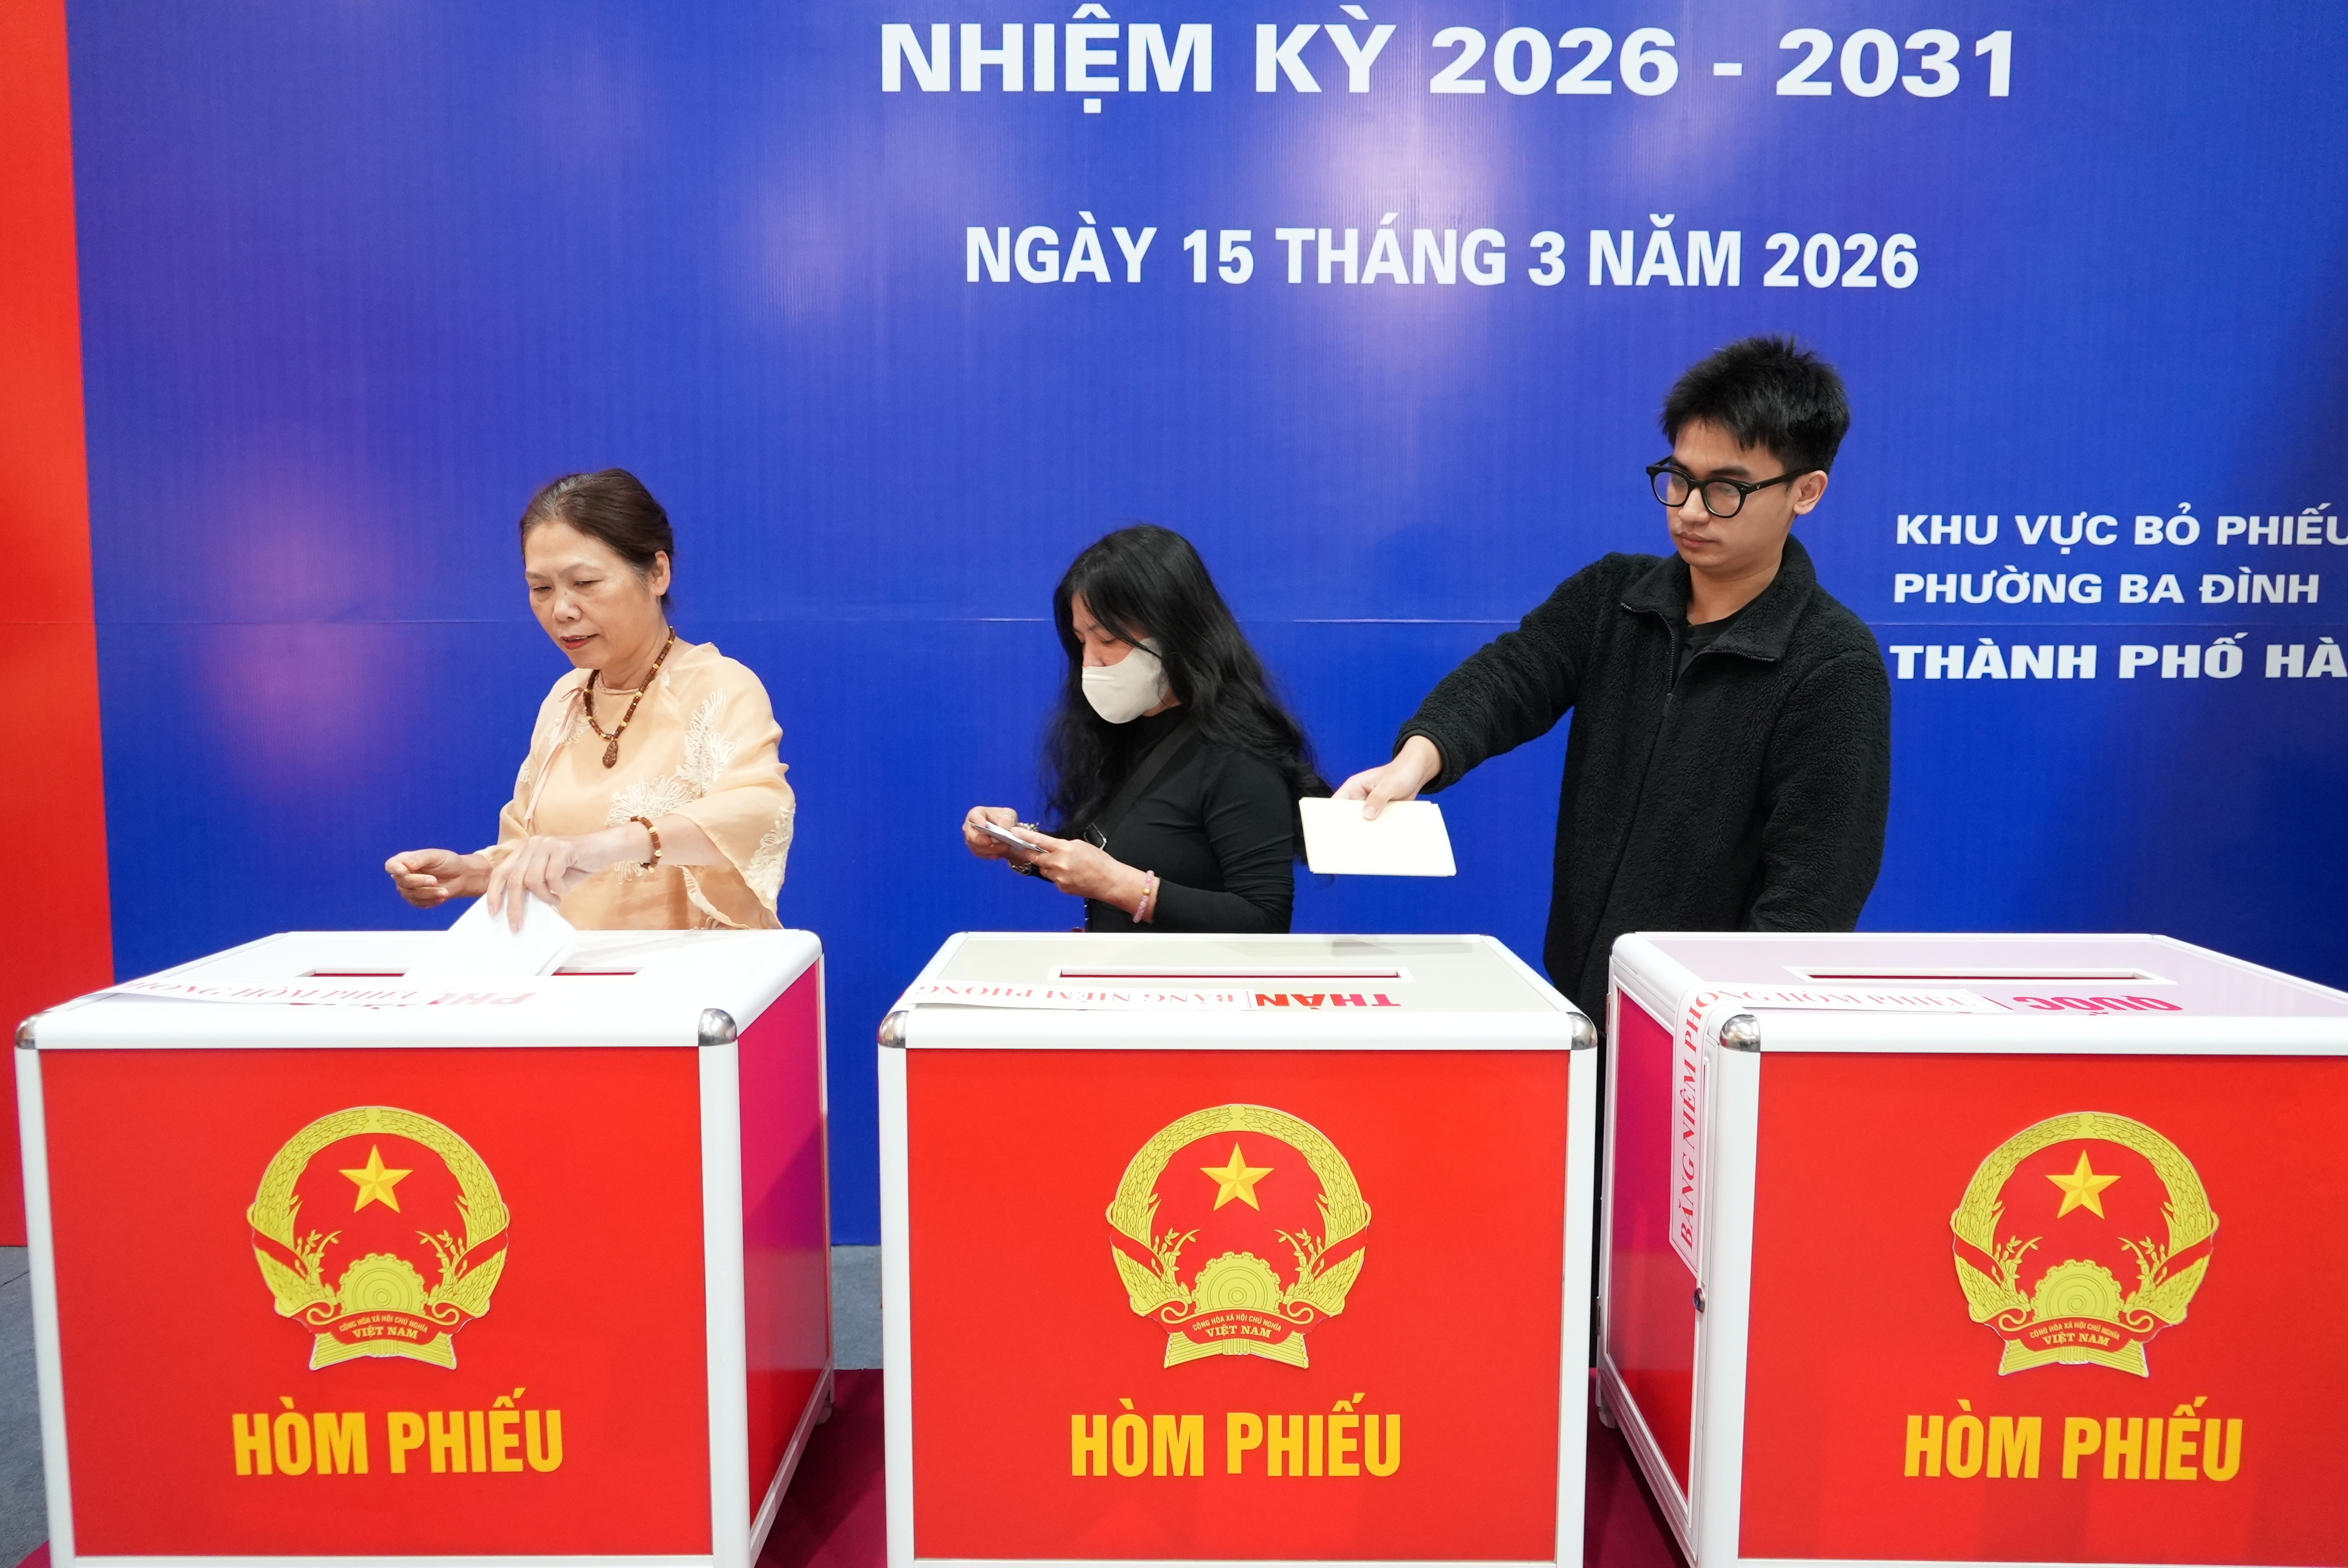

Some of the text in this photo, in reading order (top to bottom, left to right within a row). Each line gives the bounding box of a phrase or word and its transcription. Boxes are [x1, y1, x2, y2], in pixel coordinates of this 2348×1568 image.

[881, 3, 1213, 114] NHIỆM
[1255, 4, 1397, 94] KỲ
[1429, 27, 1679, 96] 2026
[1775, 28, 2012, 97] 2031
[966, 204, 1919, 289] NGÀY 15 THÁNG 3 NĂM 2026
[1896, 502, 2348, 555] KHU VỰC BỎ PHIẾU
[1893, 564, 2319, 605] PHƯỜNG BA ĐÌNH
[1888, 632, 2348, 680] THÀNH PHỐ HÀ
[2012, 995, 2184, 1016] QUỐC
[352, 1325, 419, 1339] VIỆT NAM
[1206, 1324, 1272, 1338] VIỆT NAM
[2043, 1332, 2110, 1347] VIỆT NAM
[232, 1387, 564, 1476] HÒM PHIẾU
[1071, 1392, 1401, 1477] HÒM PHIẾU
[1904, 1396, 2243, 1482] HÒM PHIẾU
